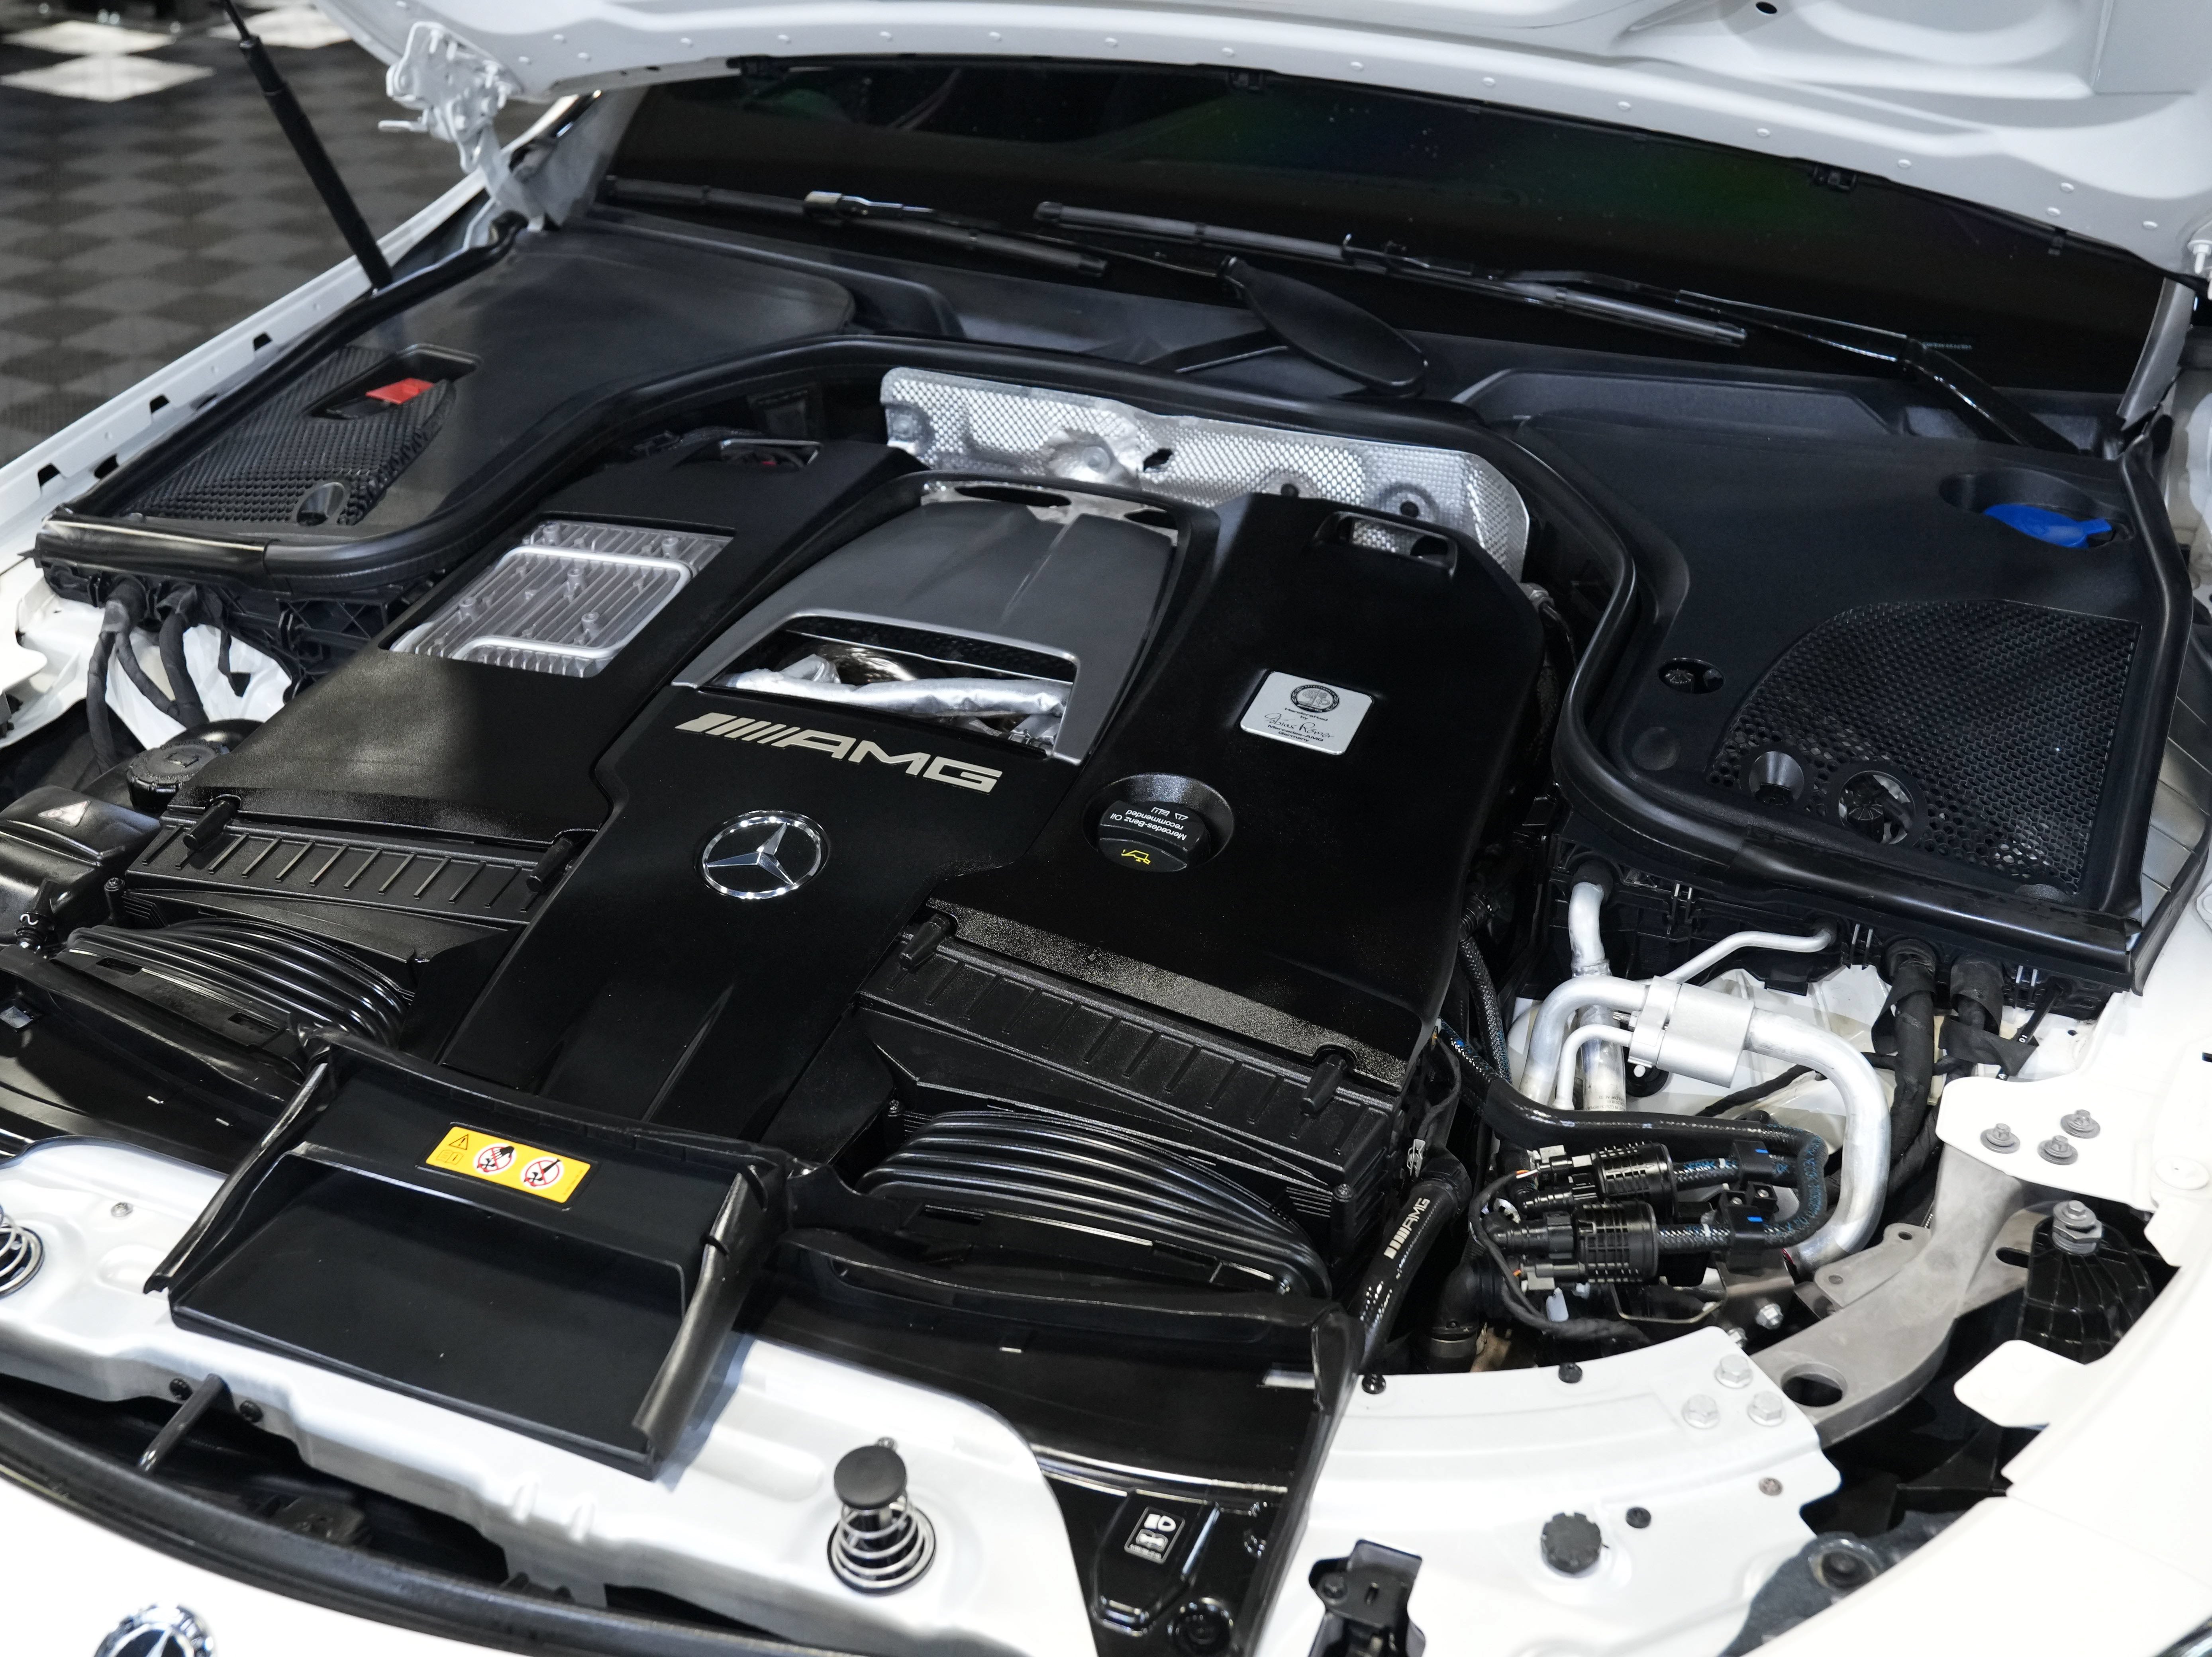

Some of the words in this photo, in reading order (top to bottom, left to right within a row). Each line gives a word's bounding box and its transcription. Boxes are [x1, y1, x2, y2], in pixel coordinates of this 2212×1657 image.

[1284, 707, 1328, 721] Handcrafted
[1268, 724, 1324, 742] Mercedes-AMG
[1278, 731, 1310, 742] Germany
[771, 726, 1003, 794] AMG
[1124, 816, 1187, 841] Mercedes-Benz
[1125, 809, 1184, 830] recommended
